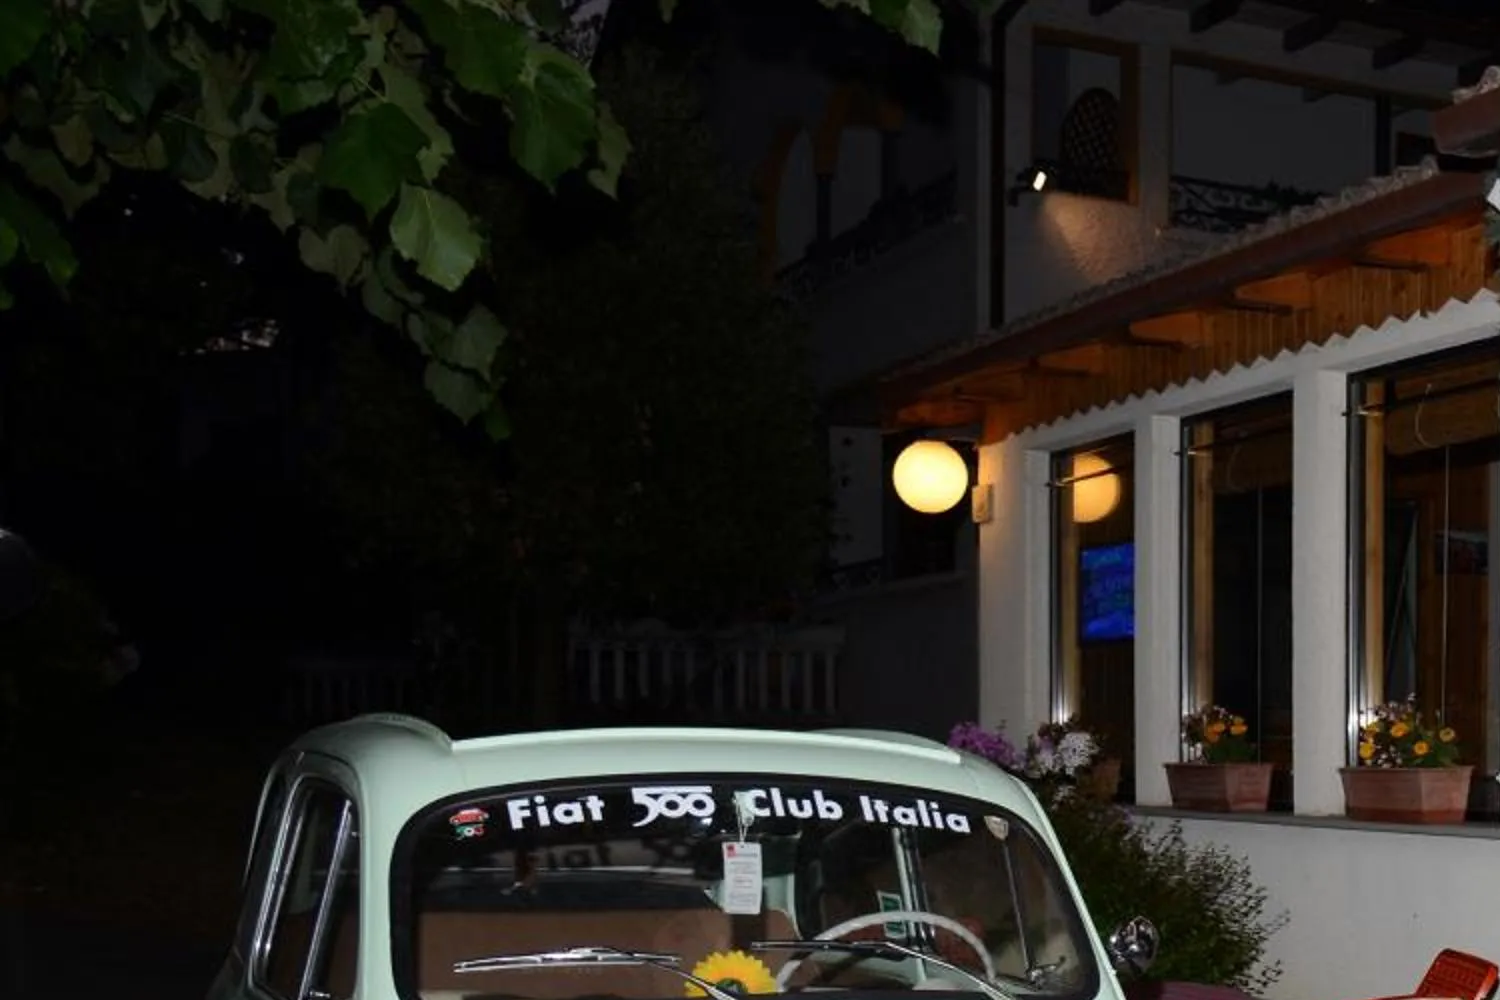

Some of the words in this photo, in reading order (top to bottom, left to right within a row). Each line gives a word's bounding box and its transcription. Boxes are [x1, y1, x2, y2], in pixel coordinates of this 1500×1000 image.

[507, 795, 605, 830] Fiat
[631, 786, 716, 827] 500
[748, 787, 844, 820] Club
[859, 795, 972, 833] Italia
